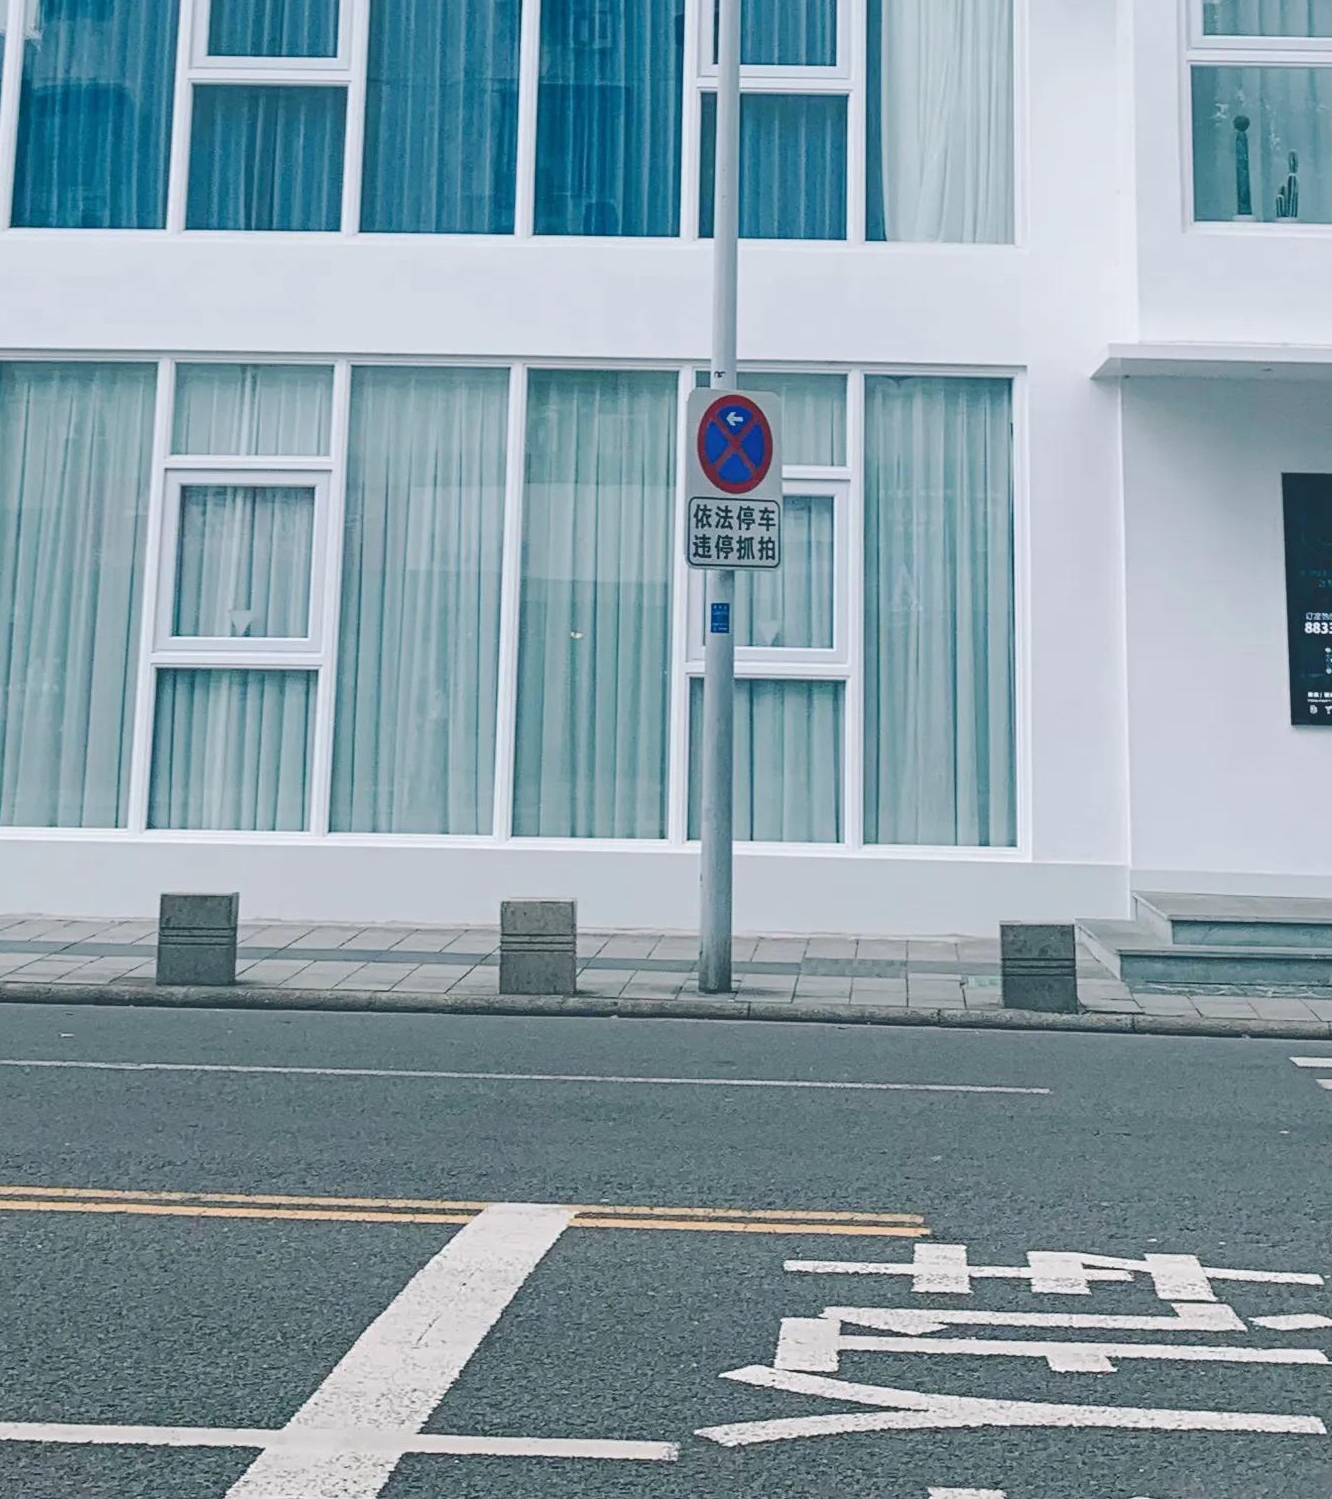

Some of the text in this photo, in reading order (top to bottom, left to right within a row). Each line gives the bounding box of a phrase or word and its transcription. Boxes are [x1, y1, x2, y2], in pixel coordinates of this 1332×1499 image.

[693, 503, 777, 532] 依法停车
[692, 533, 776, 561] 违停抓拍
